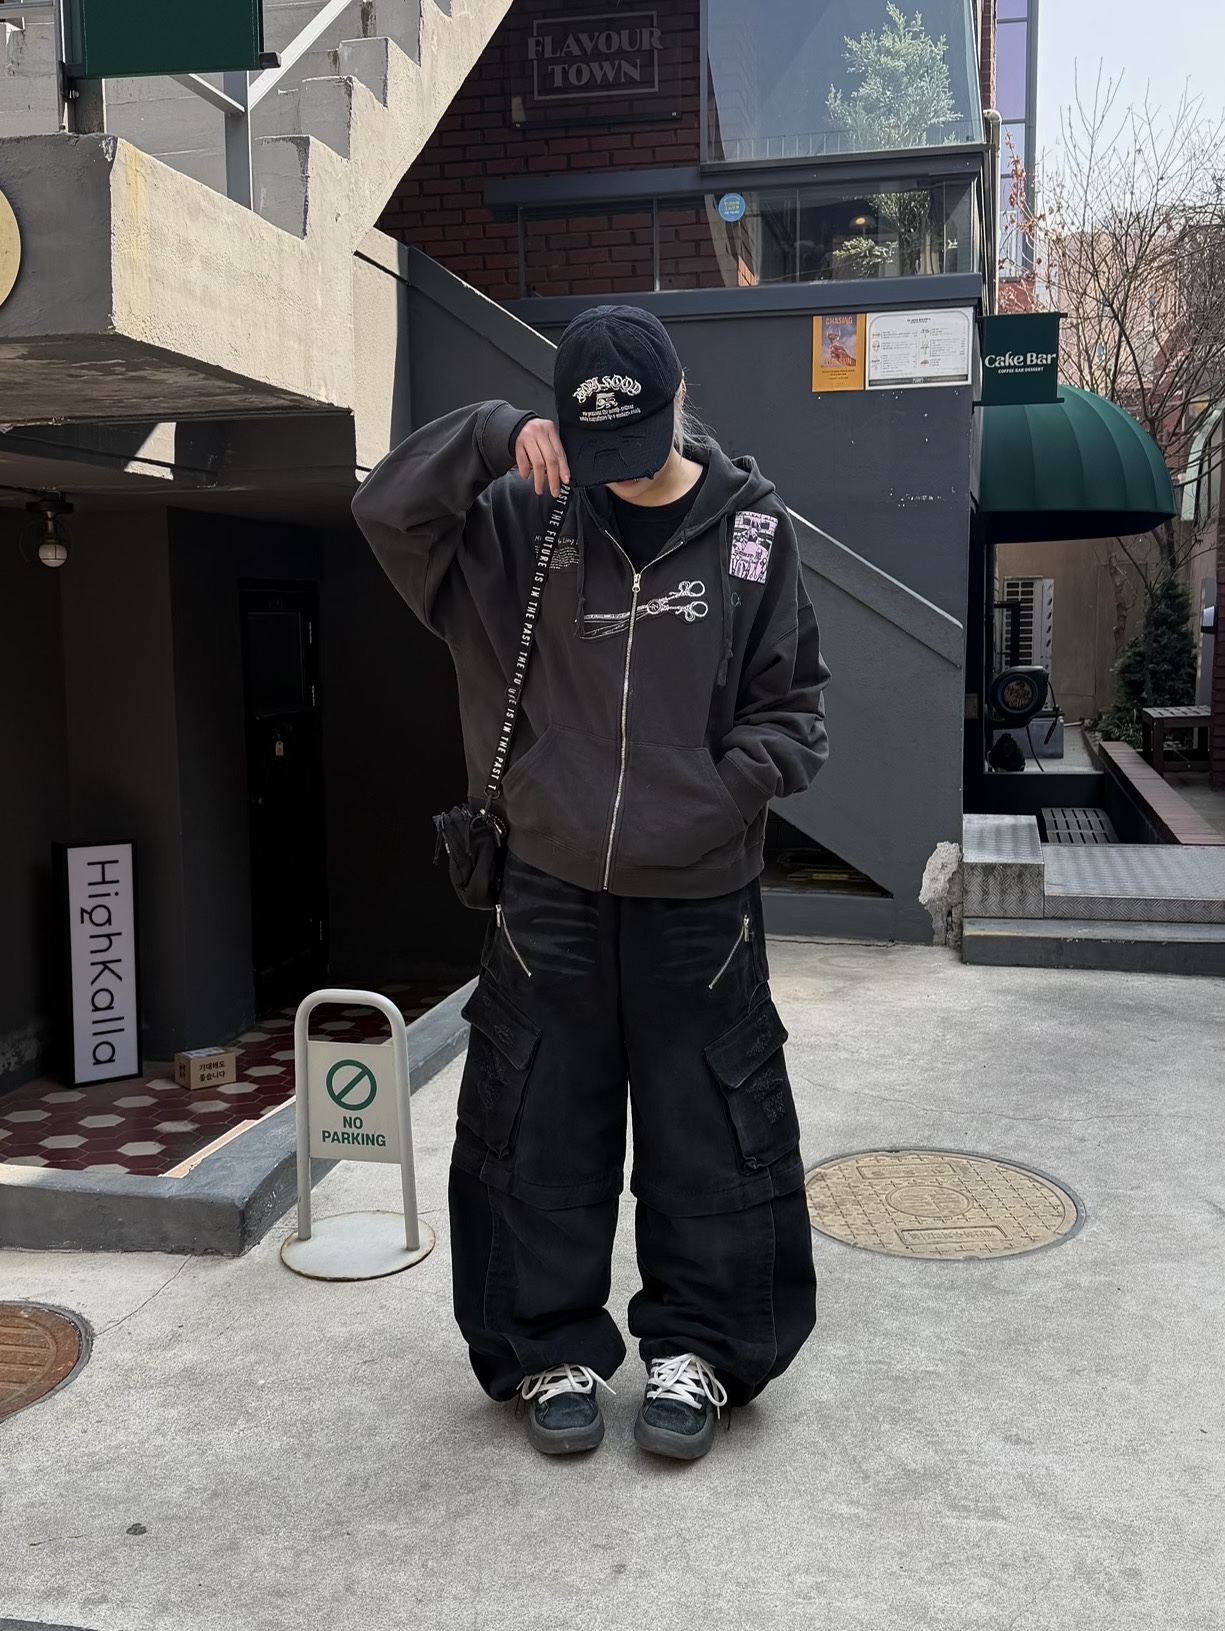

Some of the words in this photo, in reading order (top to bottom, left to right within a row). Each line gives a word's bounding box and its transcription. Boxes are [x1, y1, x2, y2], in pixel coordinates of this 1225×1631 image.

[527, 28, 663, 59] FLAVOUR
[548, 59, 641, 88] TOWN
[984, 351, 1024, 368] Cake
[1026, 352, 1057, 365] Bar
[556, 483, 571, 506] PAST
[549, 509, 564, 527] THE
[537, 530, 557, 568] FUTURE
[534, 571, 545, 582] IS
[530, 586, 541, 598] IN
[525, 601, 538, 620] THE
[520, 622, 533, 647] PAST
[516, 651, 528, 669] THE
[505, 708, 515, 719] IS
[503, 721, 512, 733] IN
[497, 735, 509, 754] THE
[491, 756, 504, 780] PAST
[80, 859, 125, 1066] HighKalla
[199, 1060, 226, 1071] 기대해도
[199, 1070, 226, 1082] 좋습니다
[342, 1115, 364, 1130] NO
[321, 1130, 386, 1147] PARKING
